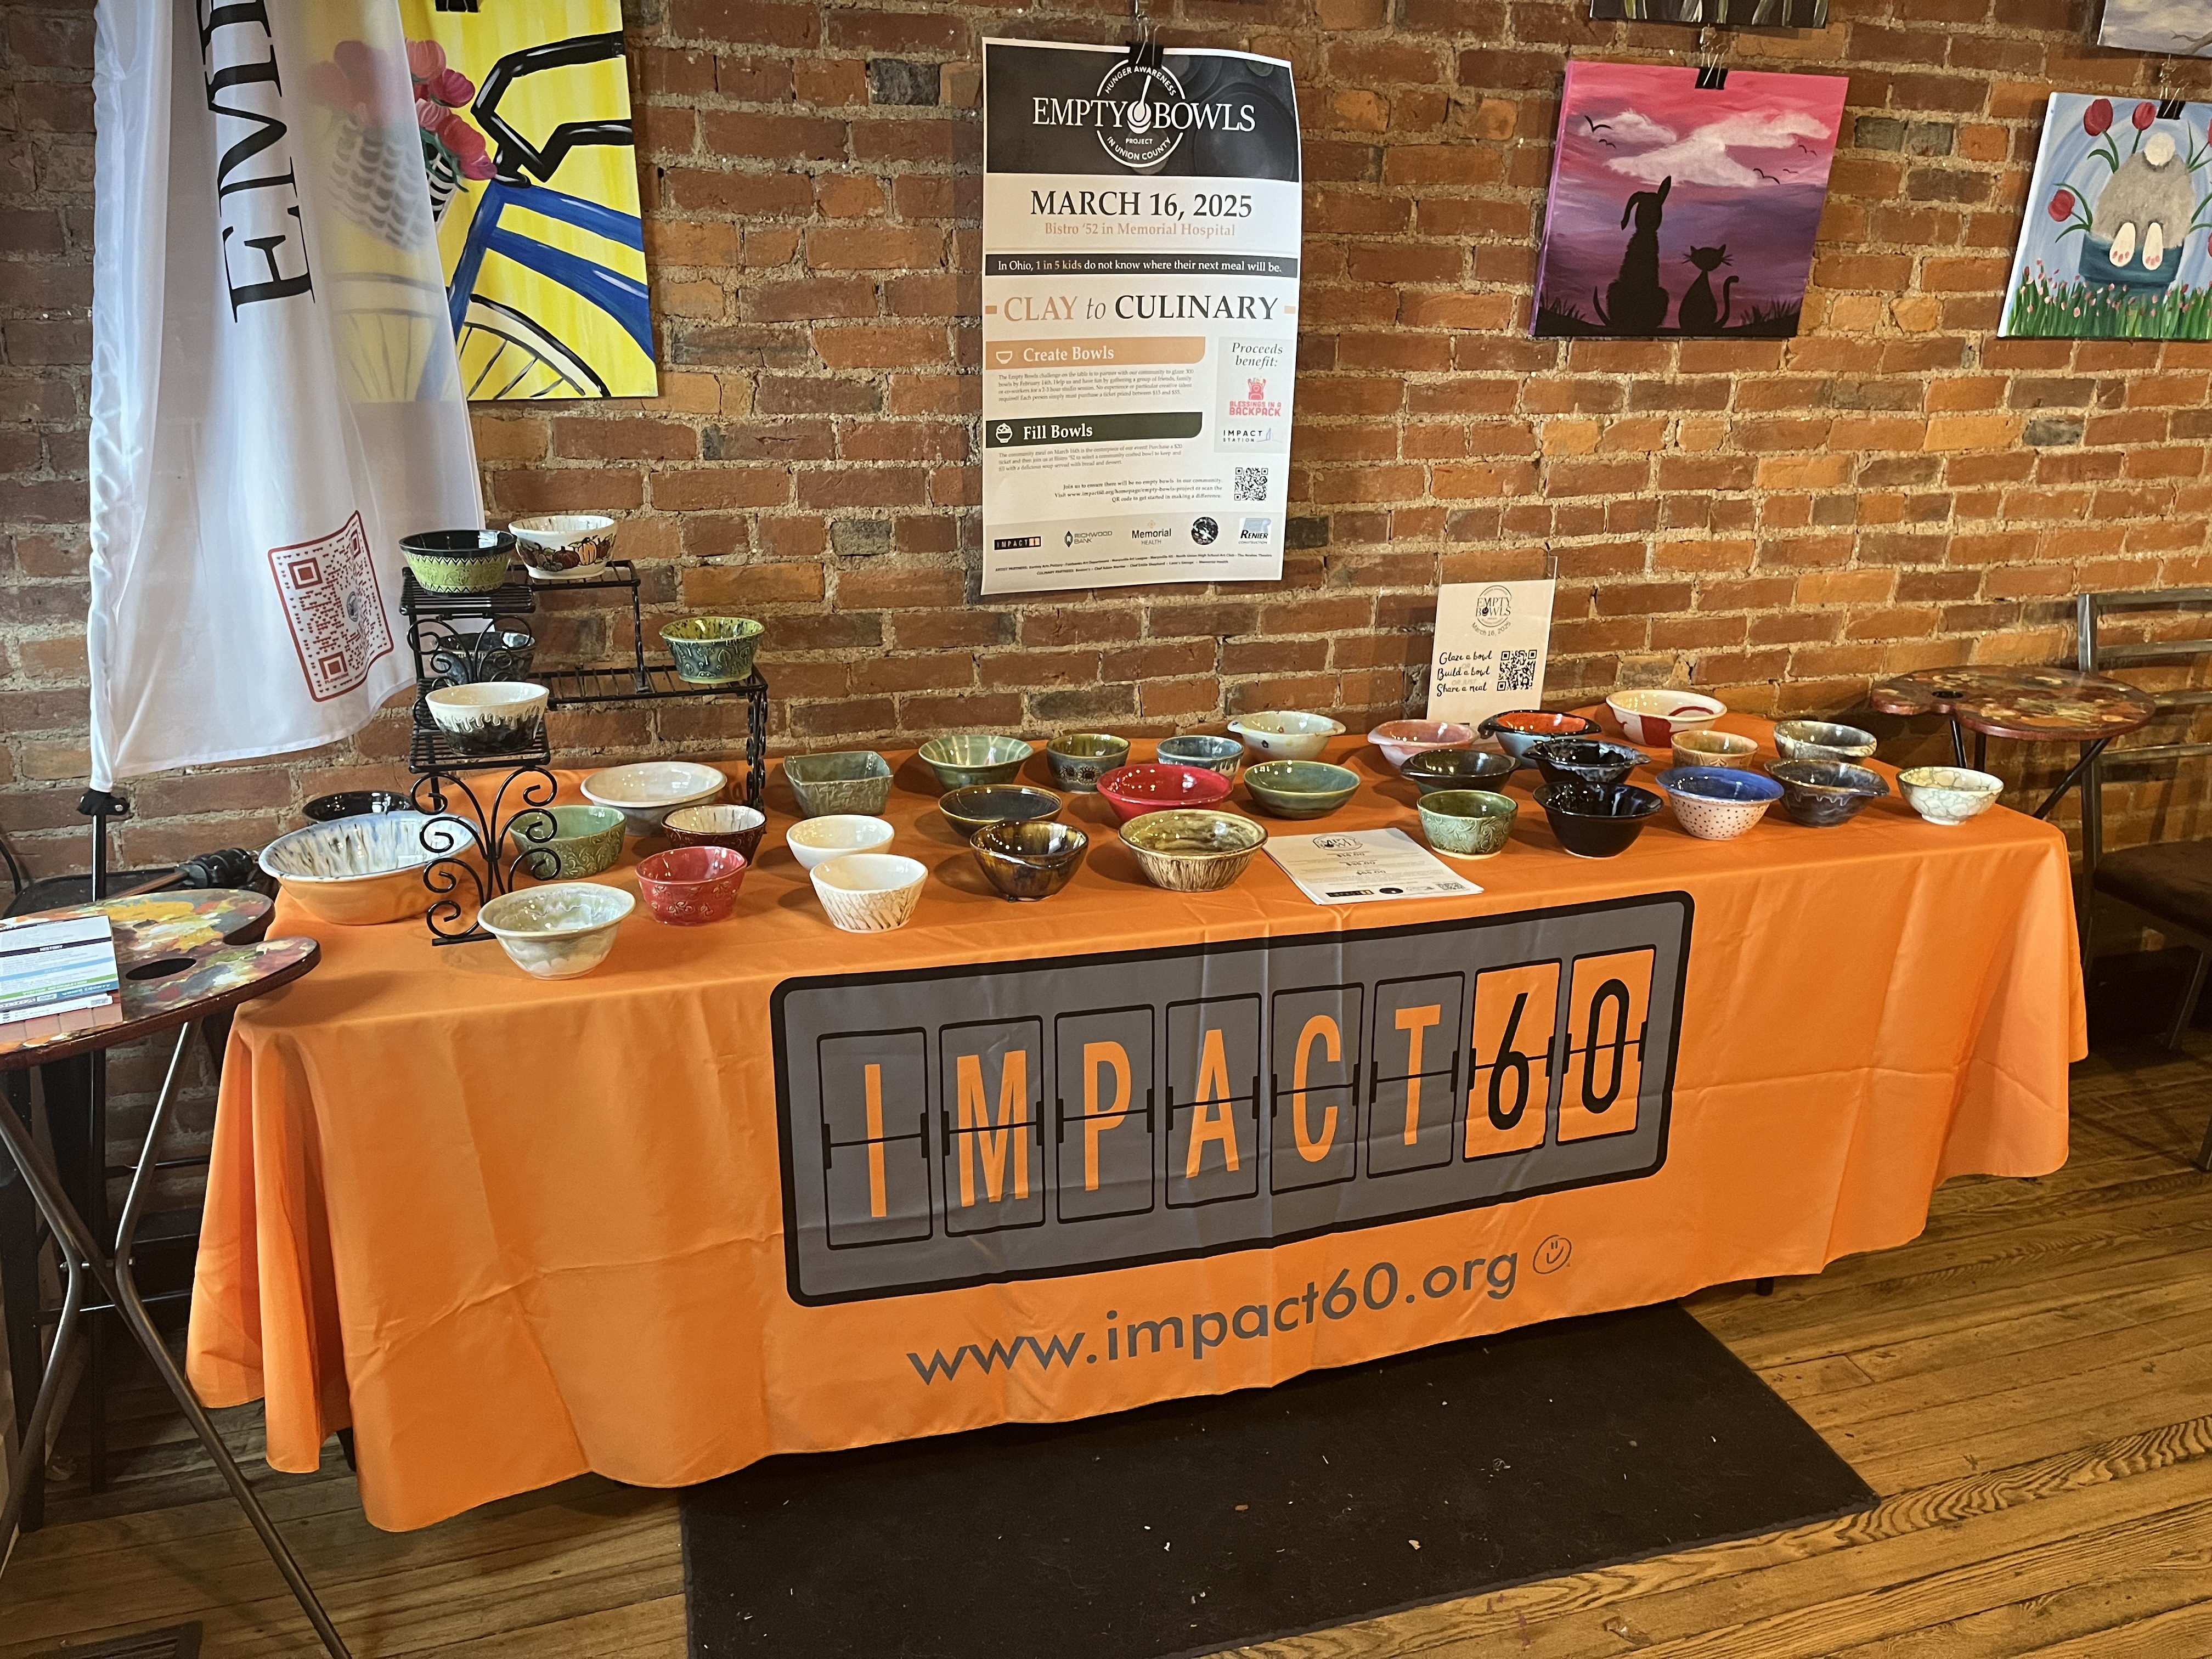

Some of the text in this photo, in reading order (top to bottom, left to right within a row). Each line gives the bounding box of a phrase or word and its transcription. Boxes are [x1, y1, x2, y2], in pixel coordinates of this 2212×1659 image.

[1105, 66, 1176, 97] HUNGER AWARENESS
[1033, 97, 1255, 132] EMPTY BOWLS
[1107, 136, 1171, 160] IN UNION COUNTY
[1031, 190, 1252, 220] MARCH 16, 2025
[1046, 223, 1079, 235] Bistro
[1102, 223, 1113, 234] in
[1118, 223, 1177, 235] Memorial
[1181, 223, 1235, 239] Hospital
[998, 259, 1281, 272] In Ohio, 1 in 5 kids do not know where their next meal will be.
[1004, 295, 1278, 321] CLAY to CULINARY
[1023, 346, 1114, 362] Create Bowls
[1232, 342, 1283, 354] Proceeds
[1236, 356, 1278, 369] benefit:
[1229, 408, 1280, 416] BACKPACK
[1023, 424, 1093, 440] Fill Bowls
[1132, 528, 1171, 539] Memorial
[1240, 530, 1268, 539] RENIER
[1477, 597, 1512, 607] EMPTY
[1476, 607, 1511, 617] BOWLS
[1471, 622, 1486, 635] March
[1440, 652, 1464, 664] Glaze
[1473, 651, 1492, 661] bowl
[1437, 667, 1462, 681] Build
[1471, 666, 1489, 676] bowl
[1437, 684, 1459, 697] Share
[1470, 682, 1487, 692] meal
[906, 1252, 1517, 1385] www.impact60.org
